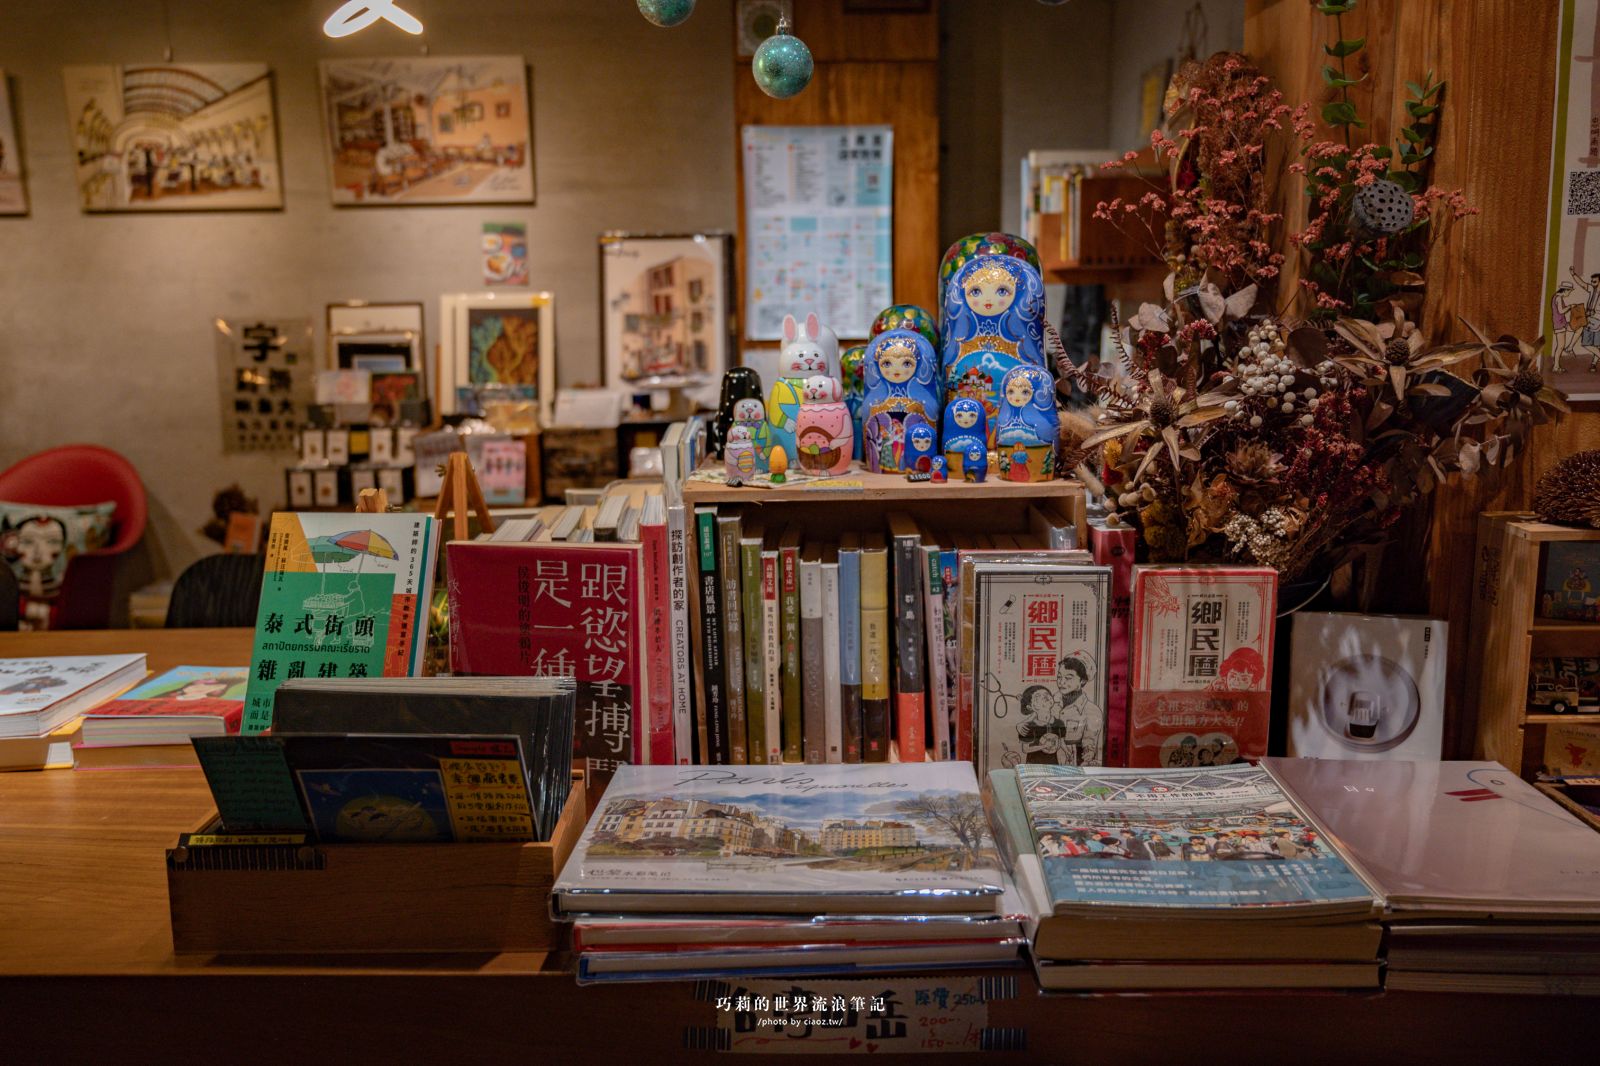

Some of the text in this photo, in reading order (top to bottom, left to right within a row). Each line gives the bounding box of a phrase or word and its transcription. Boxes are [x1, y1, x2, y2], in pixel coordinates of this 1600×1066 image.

[242, 320, 281, 362] 字
[671, 530, 685, 611] 探訪創作者的家
[264, 613, 376, 637] 泰式街頭
[258, 659, 369, 681] 雜亂建築
[675, 620, 687, 714] CREATORS AT HOME
[1136, 791, 1216, 799] 不用工作的城市
